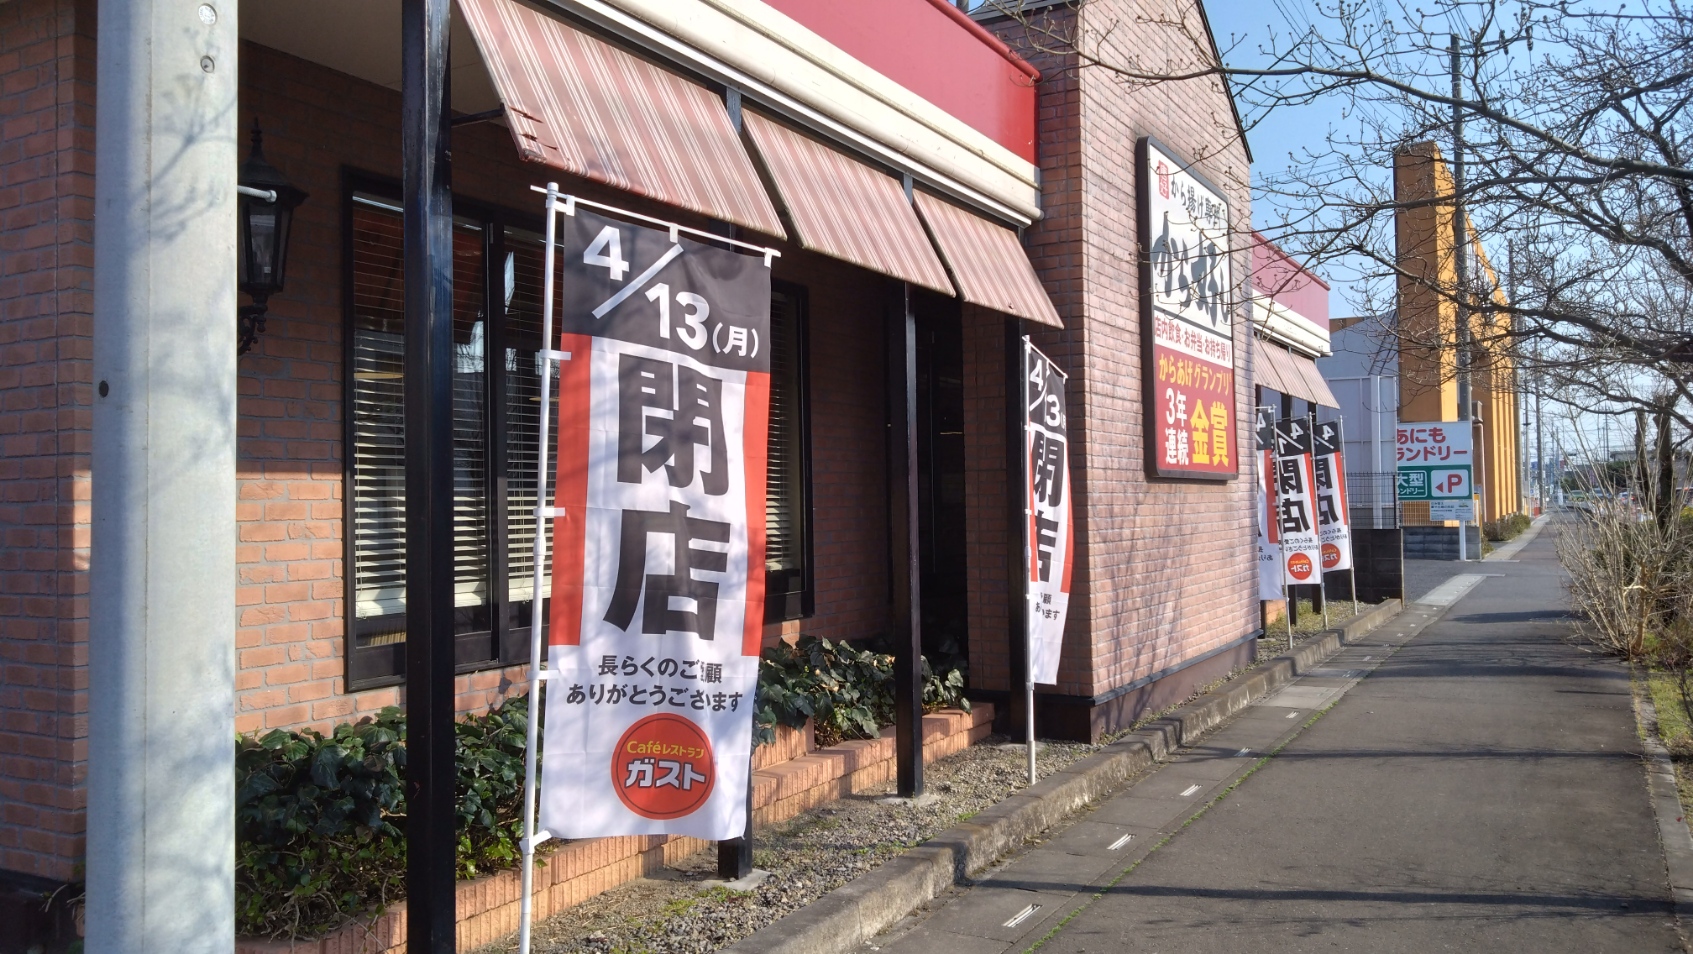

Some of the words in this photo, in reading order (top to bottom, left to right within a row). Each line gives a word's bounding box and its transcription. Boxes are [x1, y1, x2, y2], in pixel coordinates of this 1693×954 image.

[1165, 387, 1188, 427] 3年
[1165, 427, 1189, 465] 連続
[1190, 398, 1229, 467] 金賞
[603, 353, 730, 641] 閉店
[1447, 474, 1463, 493] P
[598, 655, 723, 684] 長らくのご顧
[624, 758, 706, 791] ガスト
